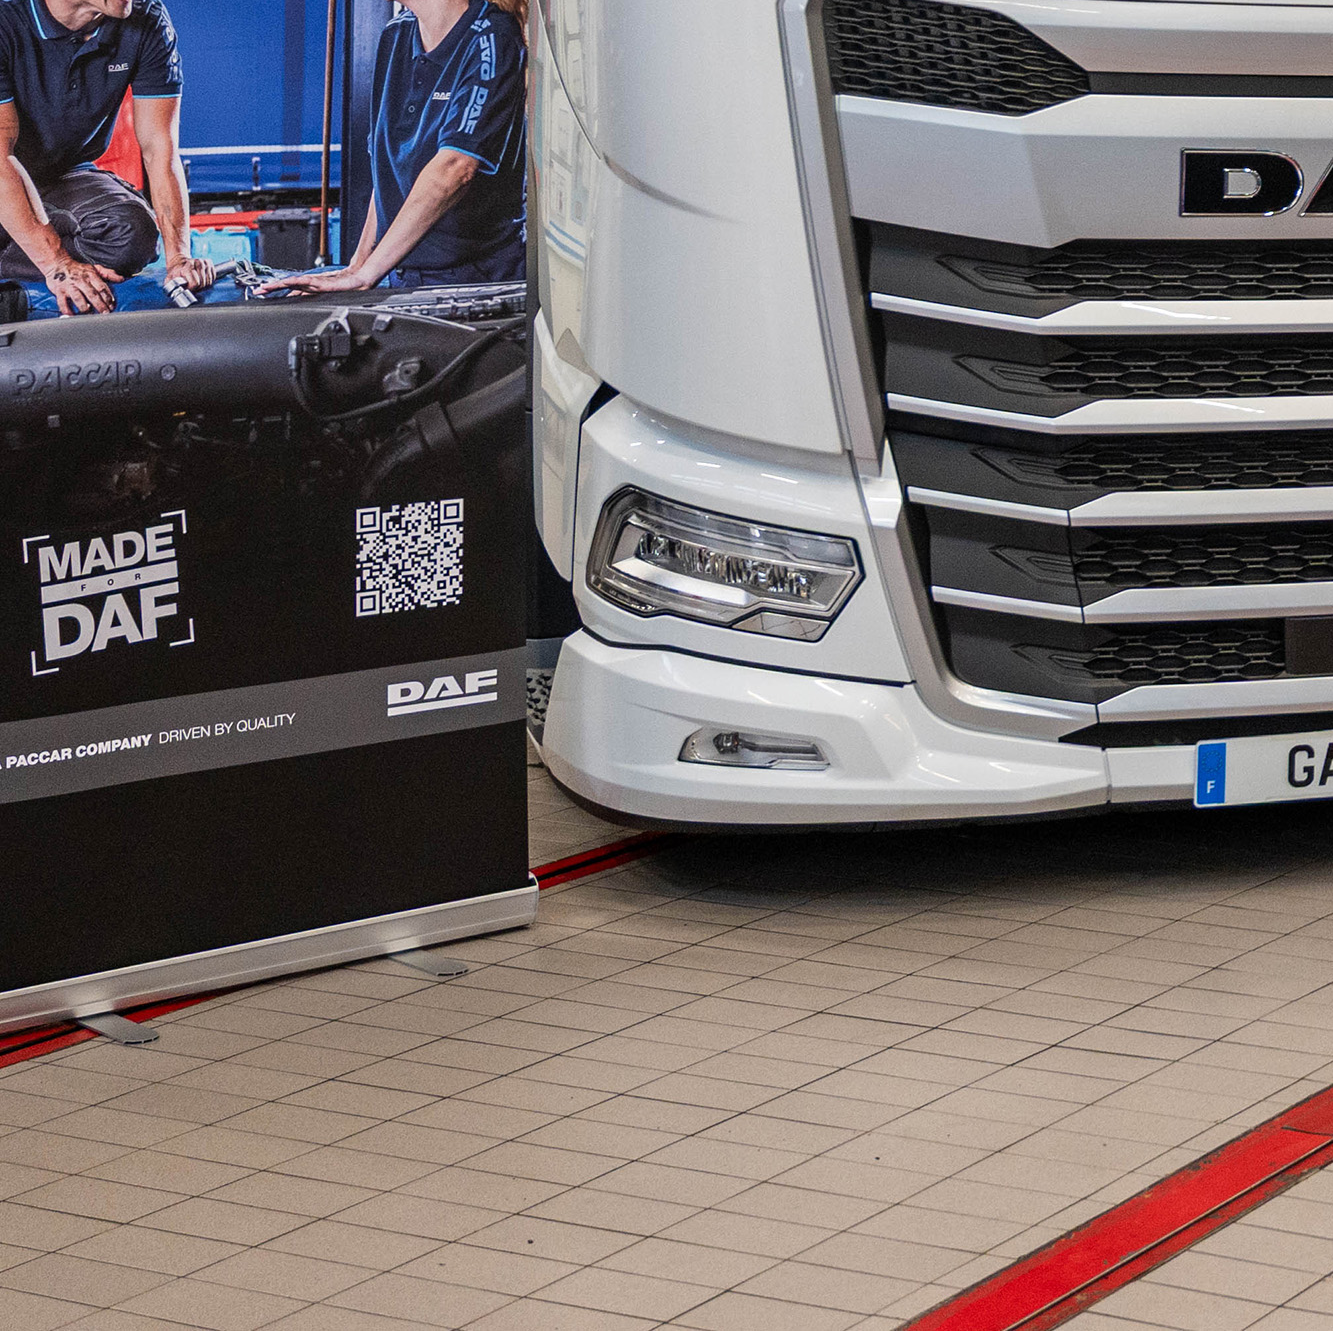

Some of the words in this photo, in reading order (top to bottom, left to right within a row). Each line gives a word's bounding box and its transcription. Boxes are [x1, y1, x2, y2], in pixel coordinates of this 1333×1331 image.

[39, 523, 175, 583] MADE
[80, 572, 144, 593] FOR
[43, 581, 180, 662] DAF
[387, 669, 498, 704] DAF
[6, 747, 73, 769] PACCAR
[75, 733, 152, 757] COMPANY
[158, 723, 211, 744] DRIVEN
[215, 721, 234, 738] BY
[236, 712, 297, 734] QUALITY
[1206, 780, 1216, 794] F
